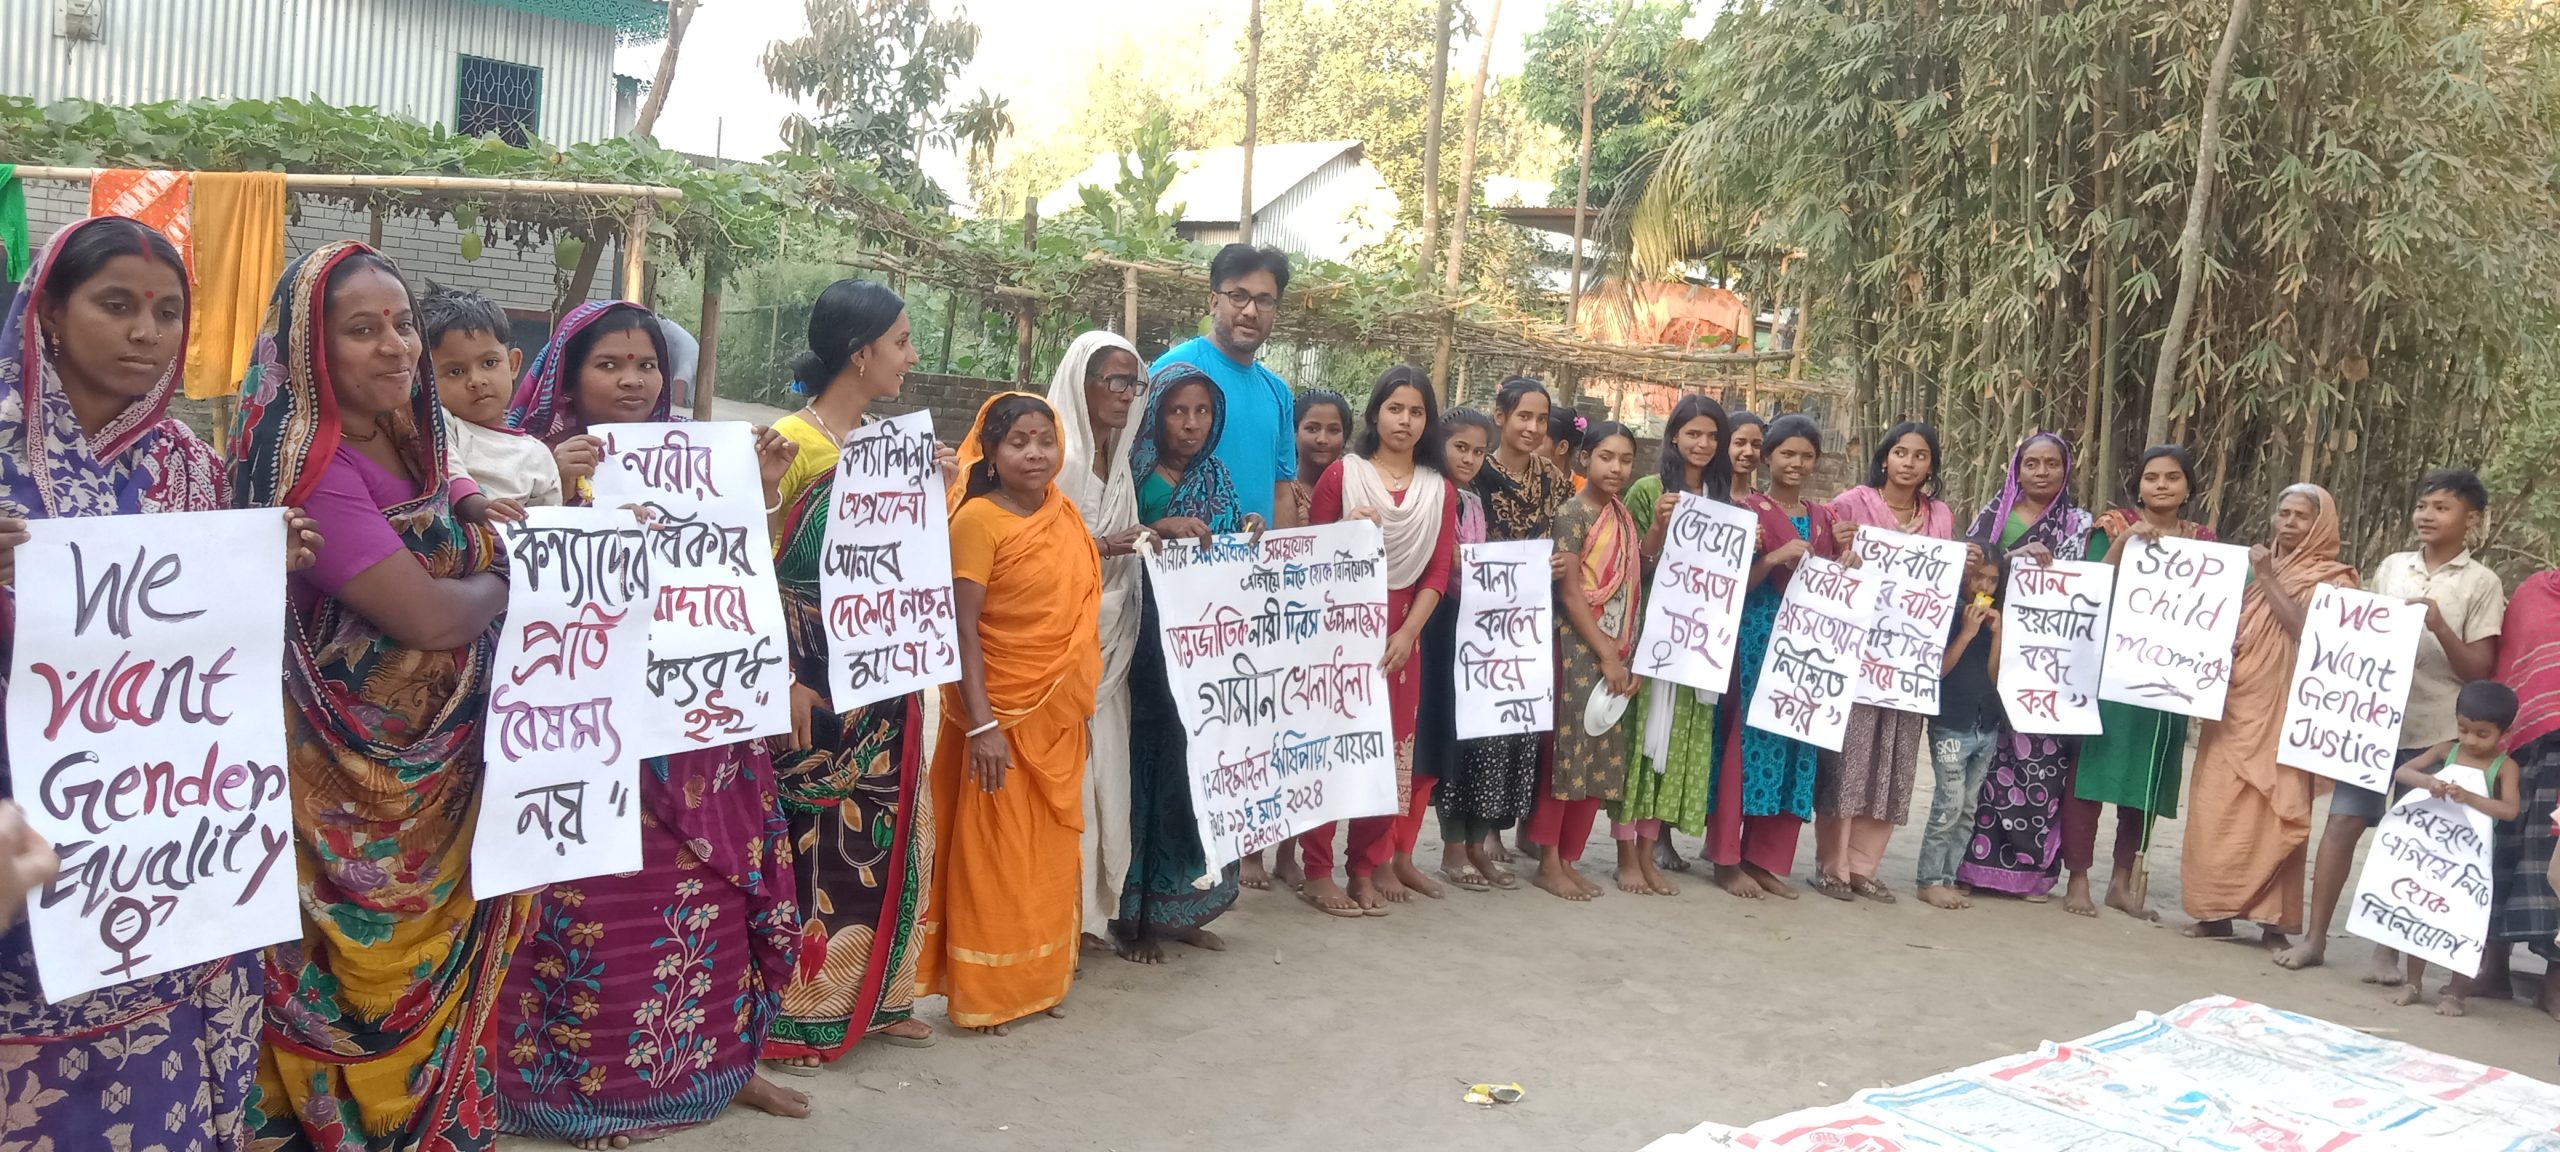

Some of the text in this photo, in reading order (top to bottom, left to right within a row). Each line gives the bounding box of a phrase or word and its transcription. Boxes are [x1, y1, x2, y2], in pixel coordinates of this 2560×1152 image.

[642, 501, 757, 577] ধিকার
[2137, 544, 2224, 588] Stop
[70, 541, 208, 640] We
[829, 588, 897, 641] দেশের
[512, 602, 627, 686] প্রতি
[1248, 597, 1280, 648] নারী
[1283, 600, 1321, 645] দিবস
[1475, 606, 1546, 648] কালে
[1459, 641, 1536, 692] বিয়ে
[2311, 632, 2396, 693] Want
[30, 646, 238, 742] Want
[2298, 676, 2401, 730] Gender
[491, 684, 621, 766] বৈষম্য
[39, 741, 287, 834] Gender
[1287, 779, 1324, 813] ২০২৪
[38, 813, 288, 918] Equality
[2391, 877, 2450, 914] হোক
